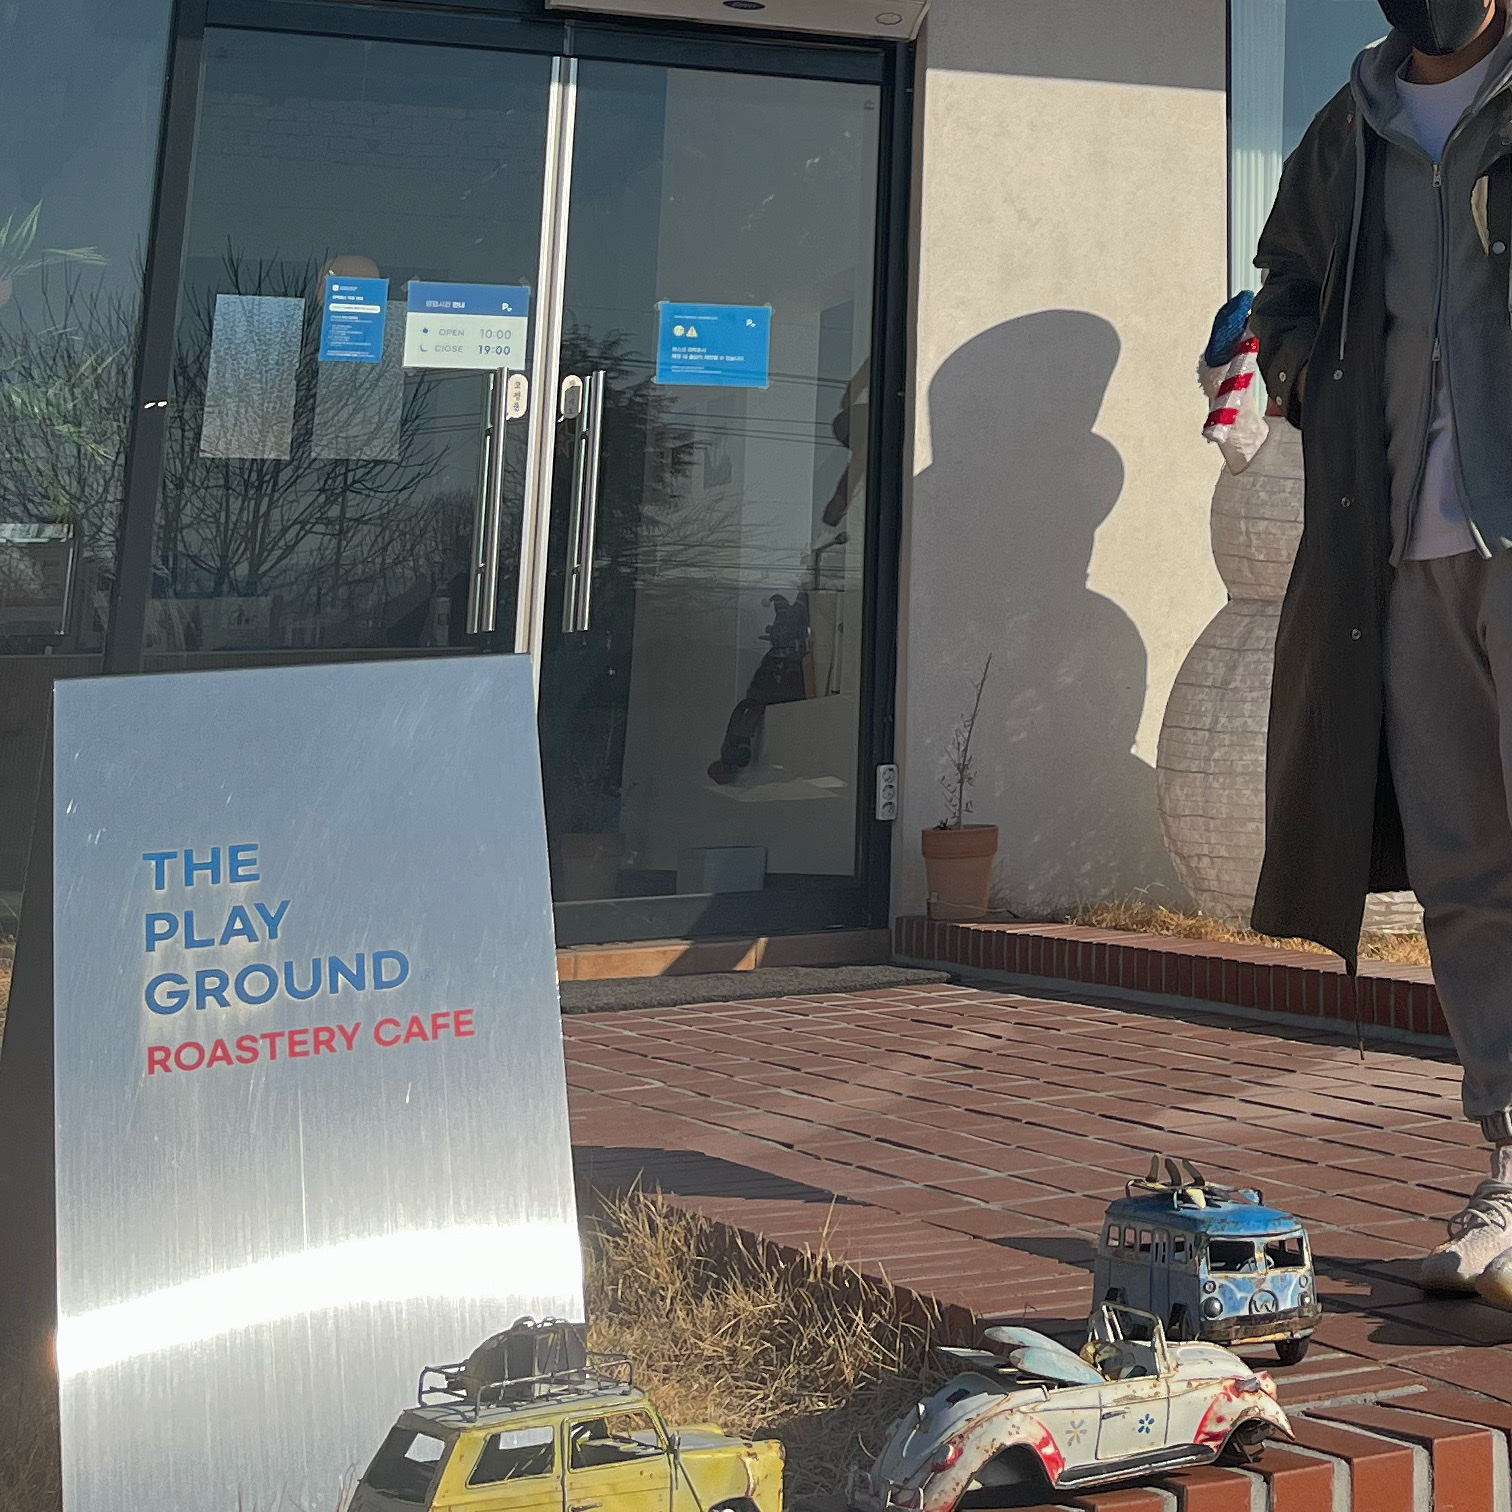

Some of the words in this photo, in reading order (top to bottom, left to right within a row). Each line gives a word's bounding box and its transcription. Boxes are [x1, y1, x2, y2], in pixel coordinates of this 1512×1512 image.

[438, 328, 465, 337] OPEN
[480, 328, 512, 340] 10:00
[478, 344, 511, 356] 19:00
[142, 843, 260, 890] THE
[145, 900, 290, 952] PLAY
[145, 950, 410, 1015] GROUND
[147, 1022, 362, 1075] ROASTERY
[373, 1008, 476, 1048] CAFE
